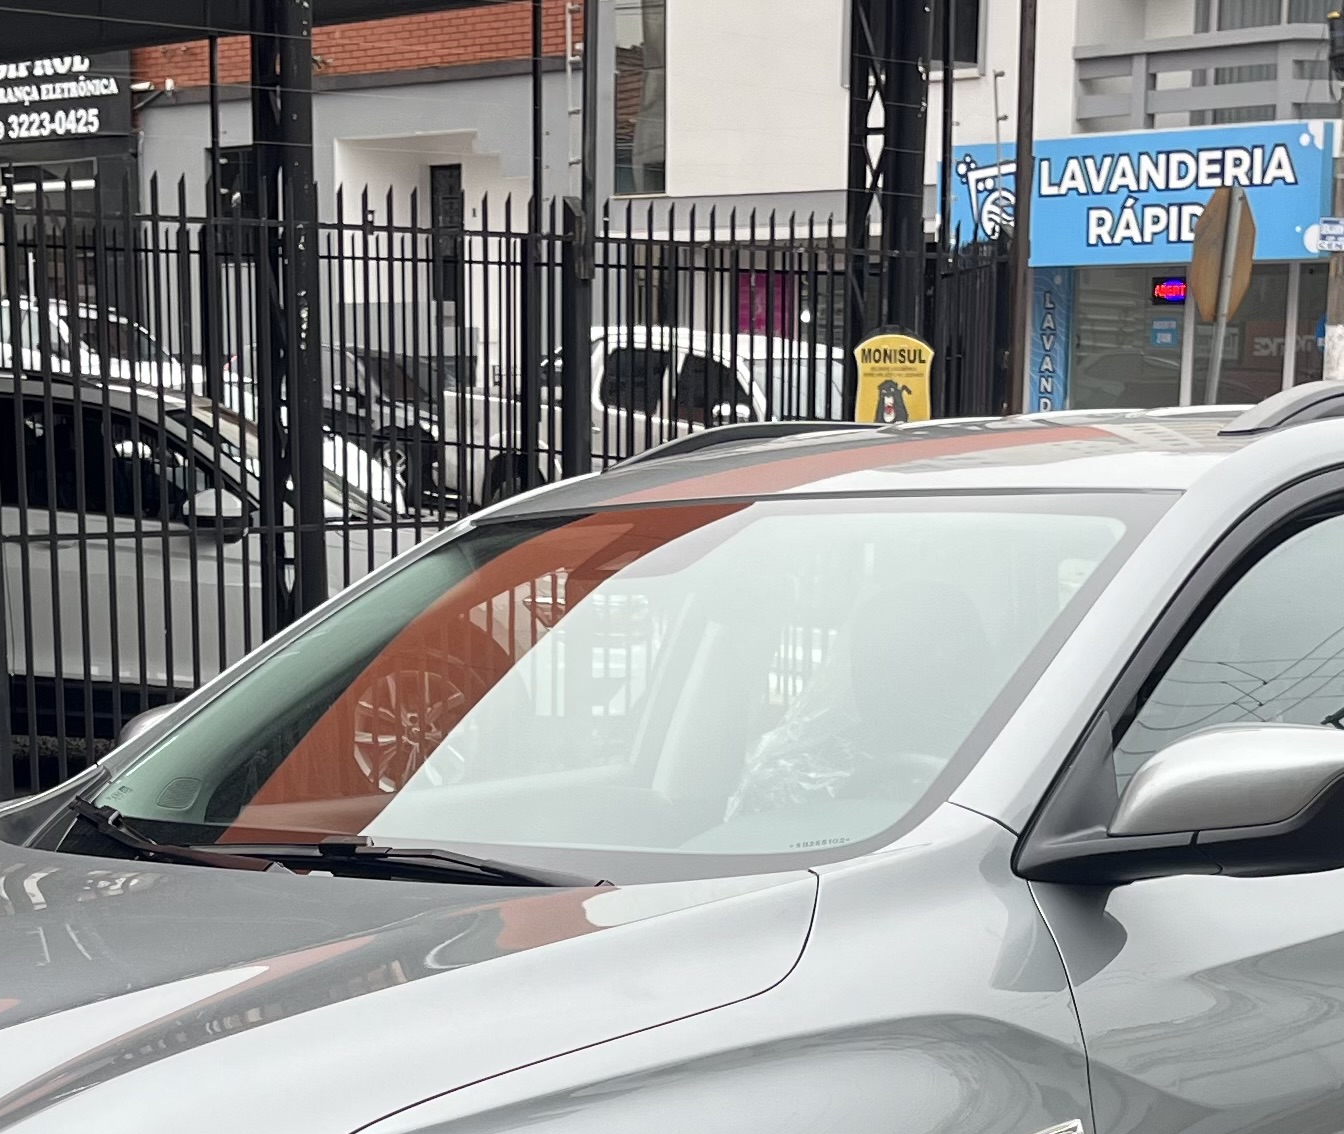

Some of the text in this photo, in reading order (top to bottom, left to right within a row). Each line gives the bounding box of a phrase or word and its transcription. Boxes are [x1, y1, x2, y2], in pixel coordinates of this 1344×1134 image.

[40, 75, 119, 100] ELETRÔNICA
[7, 107, 100, 139] 3223-0425
[1039, 143, 1298, 197] LAVANDERIA
[1086, 194, 1205, 247] RÁPID
[861, 348, 926, 364] MONISUL
